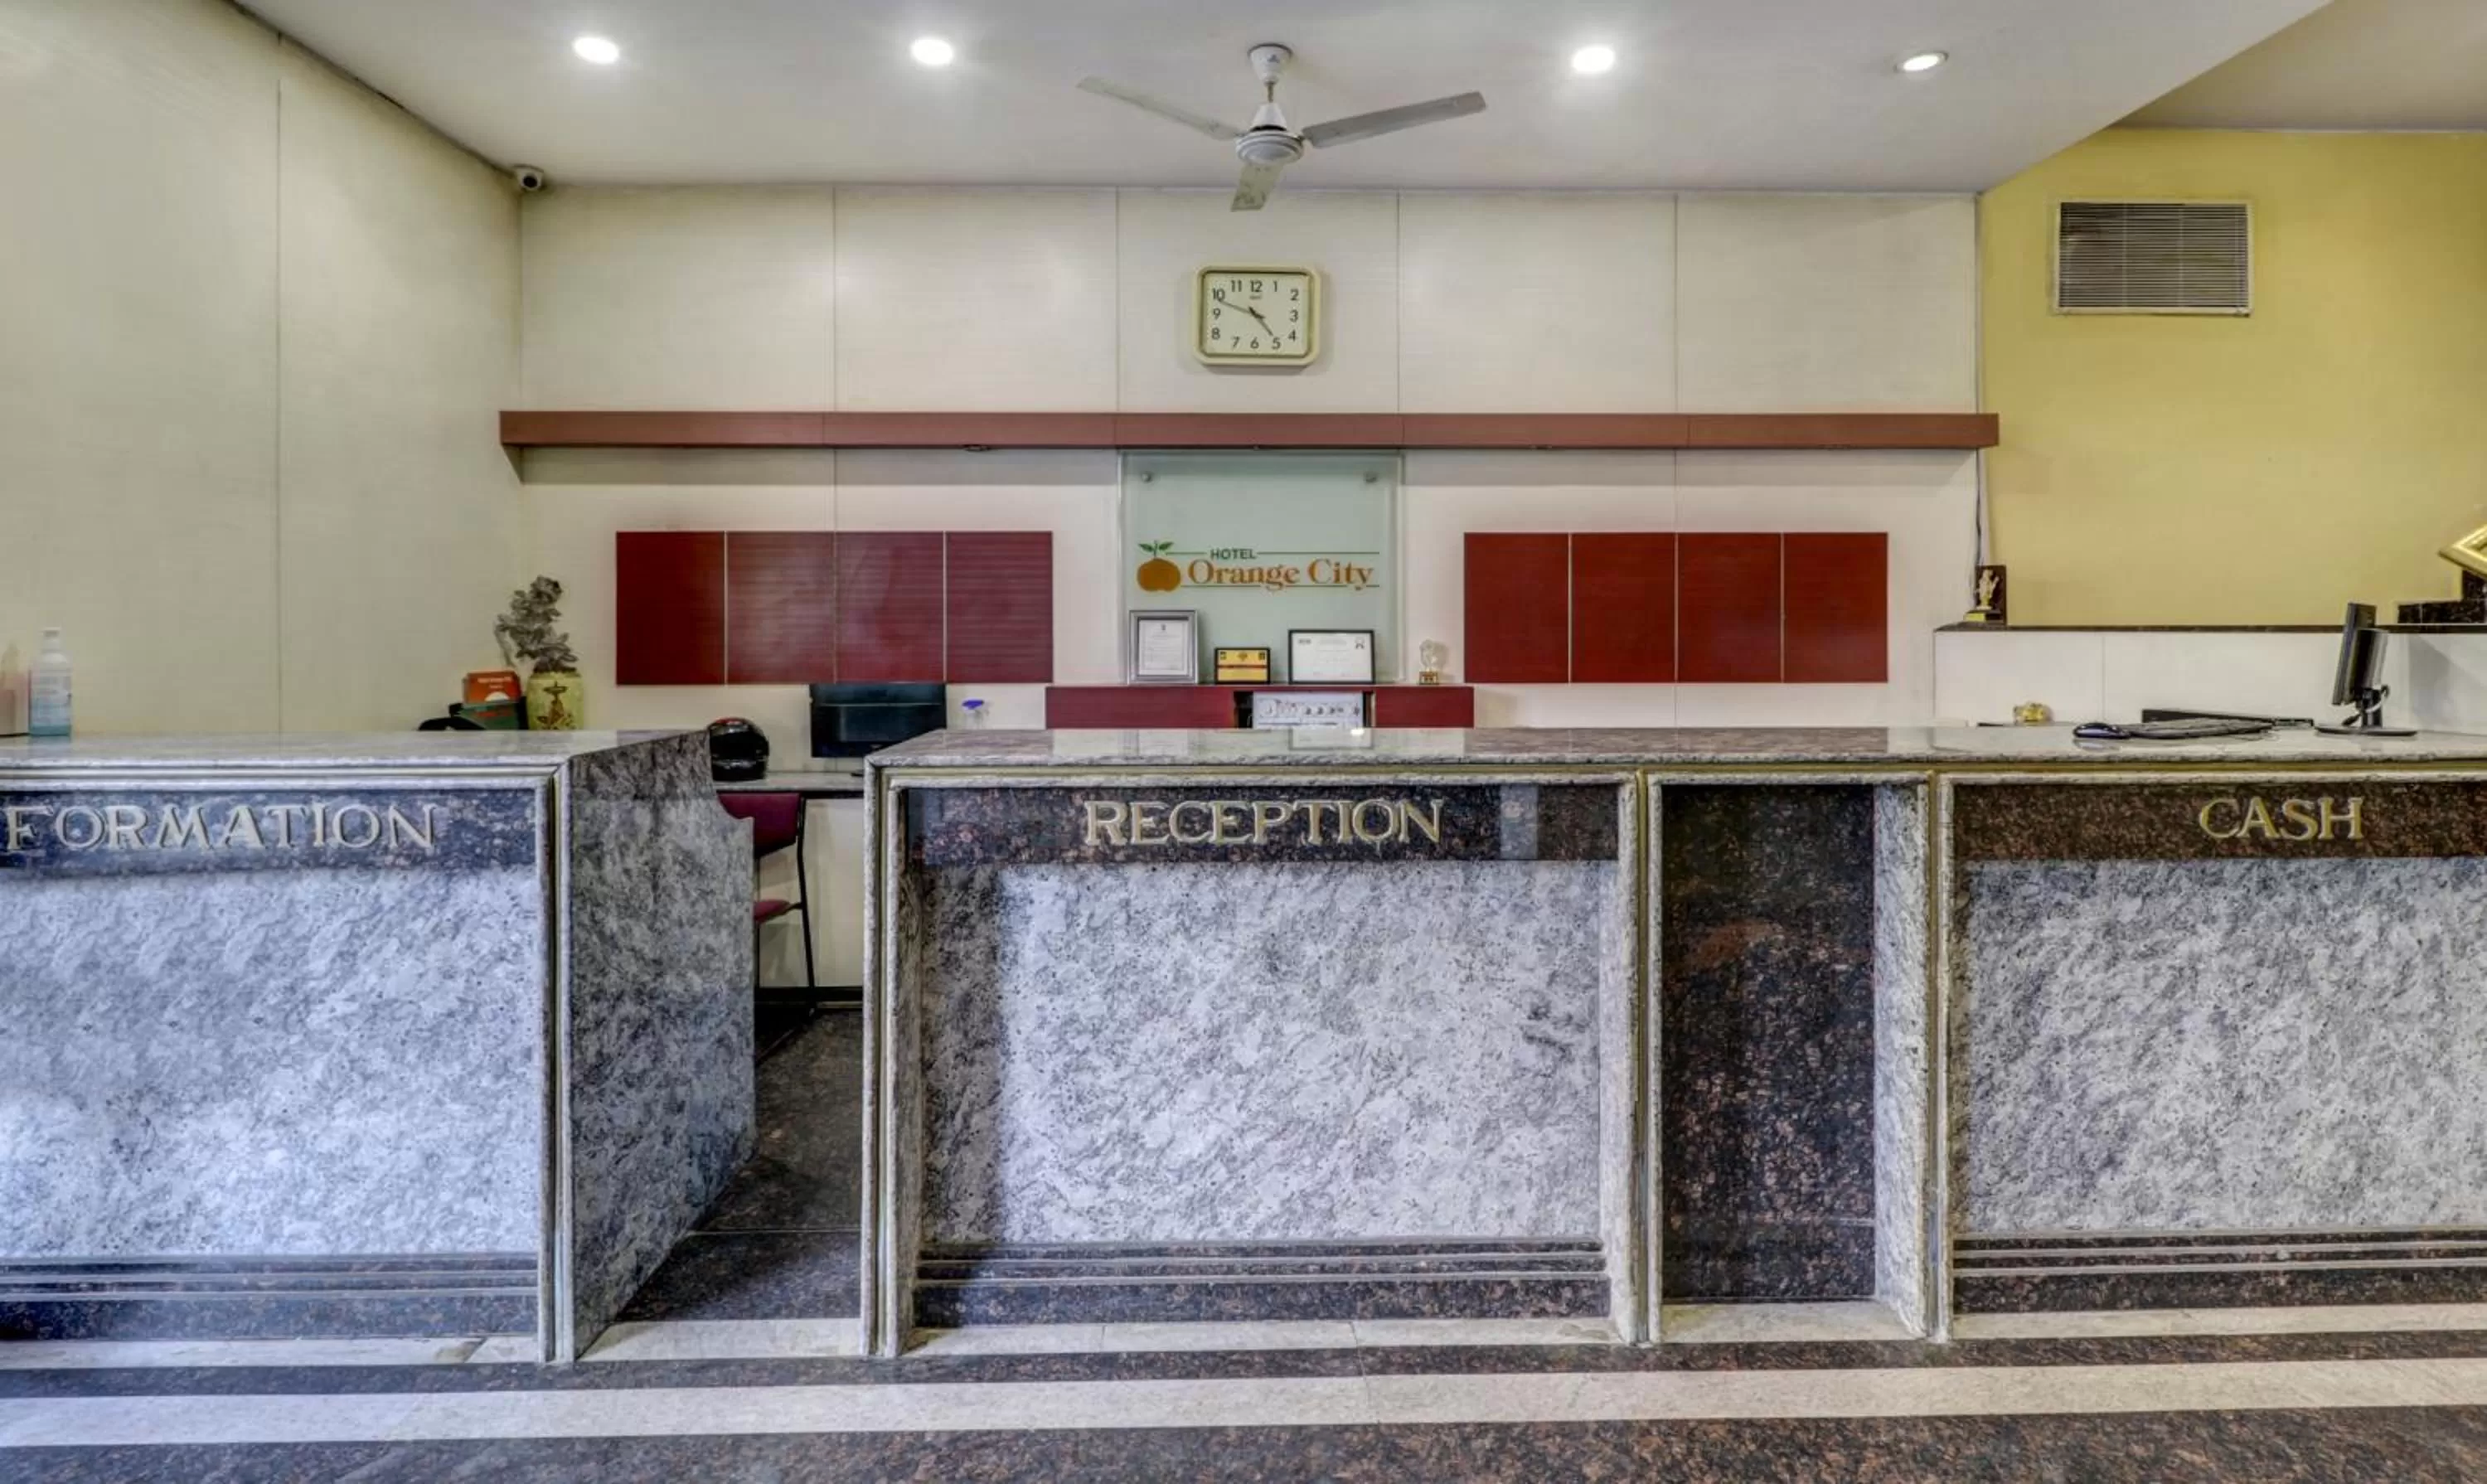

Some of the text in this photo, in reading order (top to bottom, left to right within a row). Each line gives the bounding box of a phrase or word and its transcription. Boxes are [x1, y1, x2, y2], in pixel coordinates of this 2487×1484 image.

[1230, 279, 1243, 293] 11
[1249, 279, 1263, 293] 12
[1273, 280, 1278, 293] 1
[1212, 288, 1226, 301] 10
[1290, 288, 1299, 301] 2
[1213, 308, 1221, 320] 9
[1289, 309, 1299, 323] 3
[1211, 327, 1221, 340] 8
[1287, 329, 1297, 342] 4
[1231, 336, 1240, 348] 7
[1249, 337, 1259, 349] 6
[1271, 337, 1282, 350] 5
[1210, 548, 1257, 560] HOTEL
[1187, 557, 1374, 590] Orange City
[1083, 798, 1444, 846] RECEPTION
[2199, 796, 2365, 841] CASH
[2, 803, 439, 851] FORMATION
